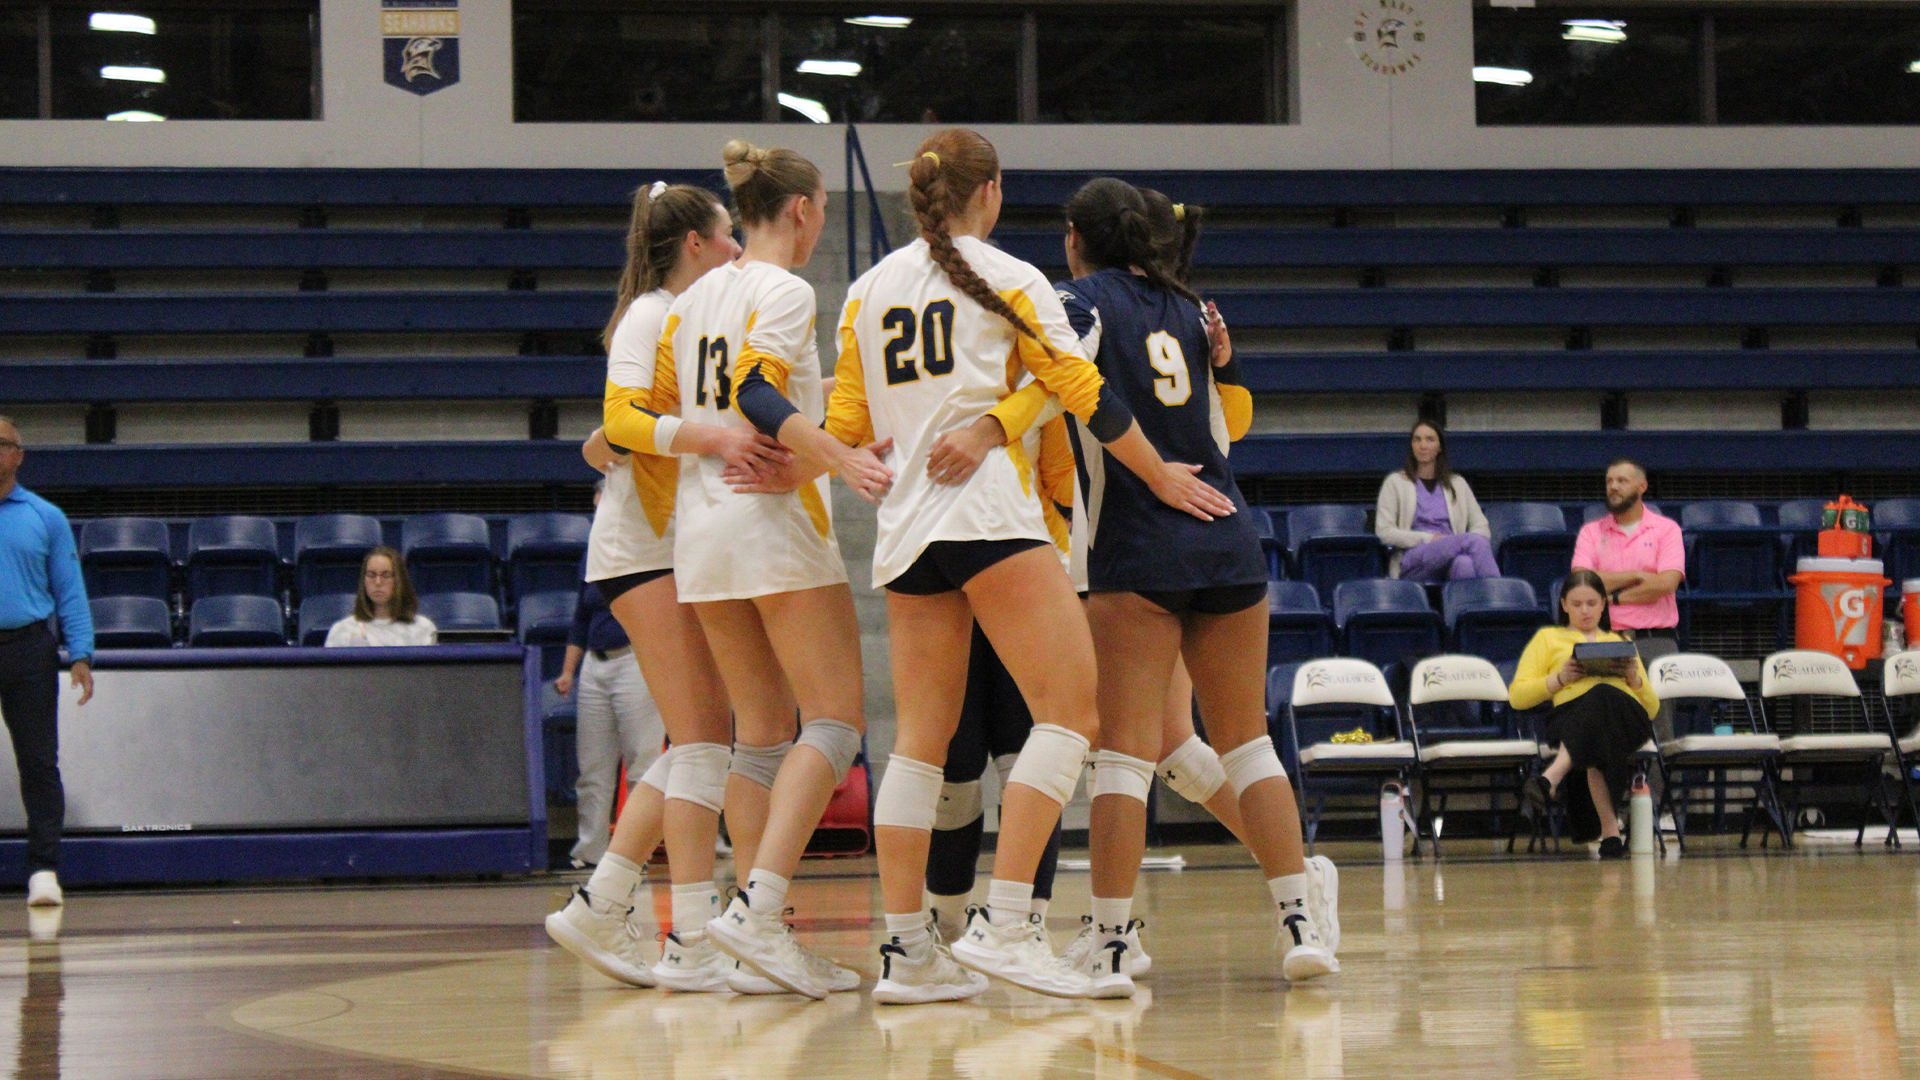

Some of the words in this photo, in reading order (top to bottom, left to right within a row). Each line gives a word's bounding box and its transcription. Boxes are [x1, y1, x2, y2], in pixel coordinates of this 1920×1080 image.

[881, 297, 957, 387] 20
[696, 334, 732, 411] 13
[1145, 330, 1192, 407] 9
[1839, 589, 1865, 618] G
[1672, 668, 1726, 679] SEAHAWKS
[1787, 664, 1841, 675] SEAHAWKS
[122, 824, 192, 832] DAKTRONICS
